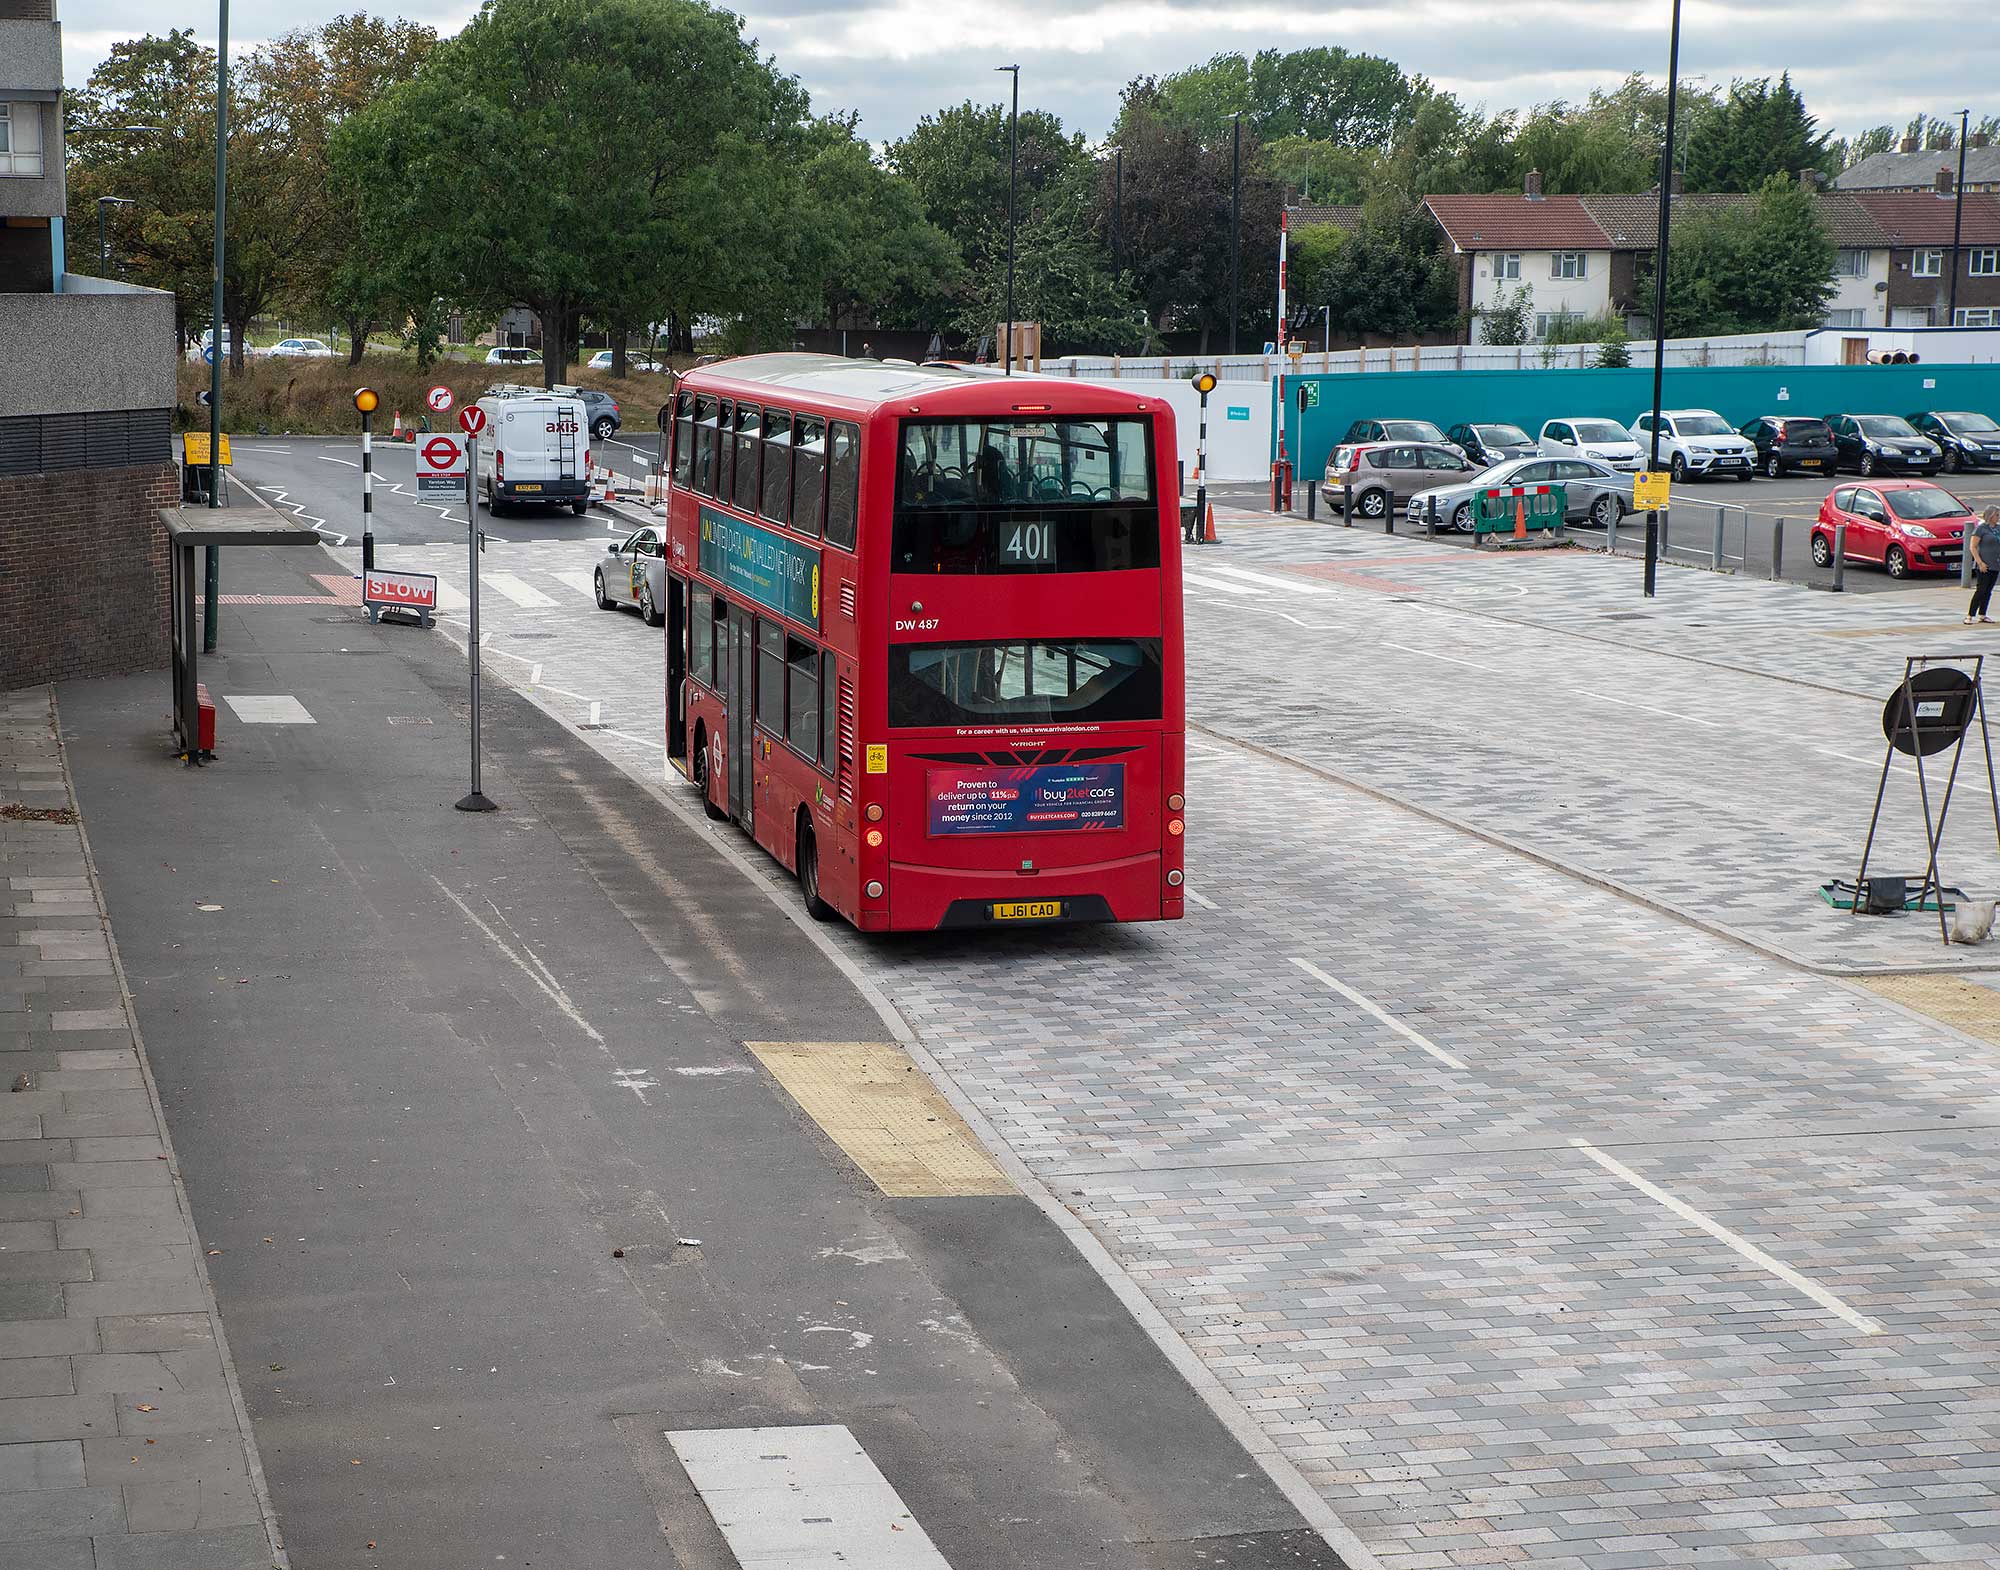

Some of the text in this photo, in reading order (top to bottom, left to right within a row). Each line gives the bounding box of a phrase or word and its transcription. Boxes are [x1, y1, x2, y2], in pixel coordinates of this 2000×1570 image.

[464, 410, 481, 430] V
[546, 418, 579, 433] axis
[1006, 524, 1048, 560] 401
[371, 580, 429, 599] SLOW
[896, 619, 939, 631] DW 487
[1034, 725, 1099, 733] www.arrivalondon.com
[957, 781, 987, 789] Proven
[938, 792, 965, 800] deliver
[966, 792, 977, 800] up
[1043, 787, 1115, 802] buy2letcars
[987, 803, 1007, 811] your
[942, 812, 1013, 822] money since 2012
[1001, 904, 1053, 917] LJ61 CAO
